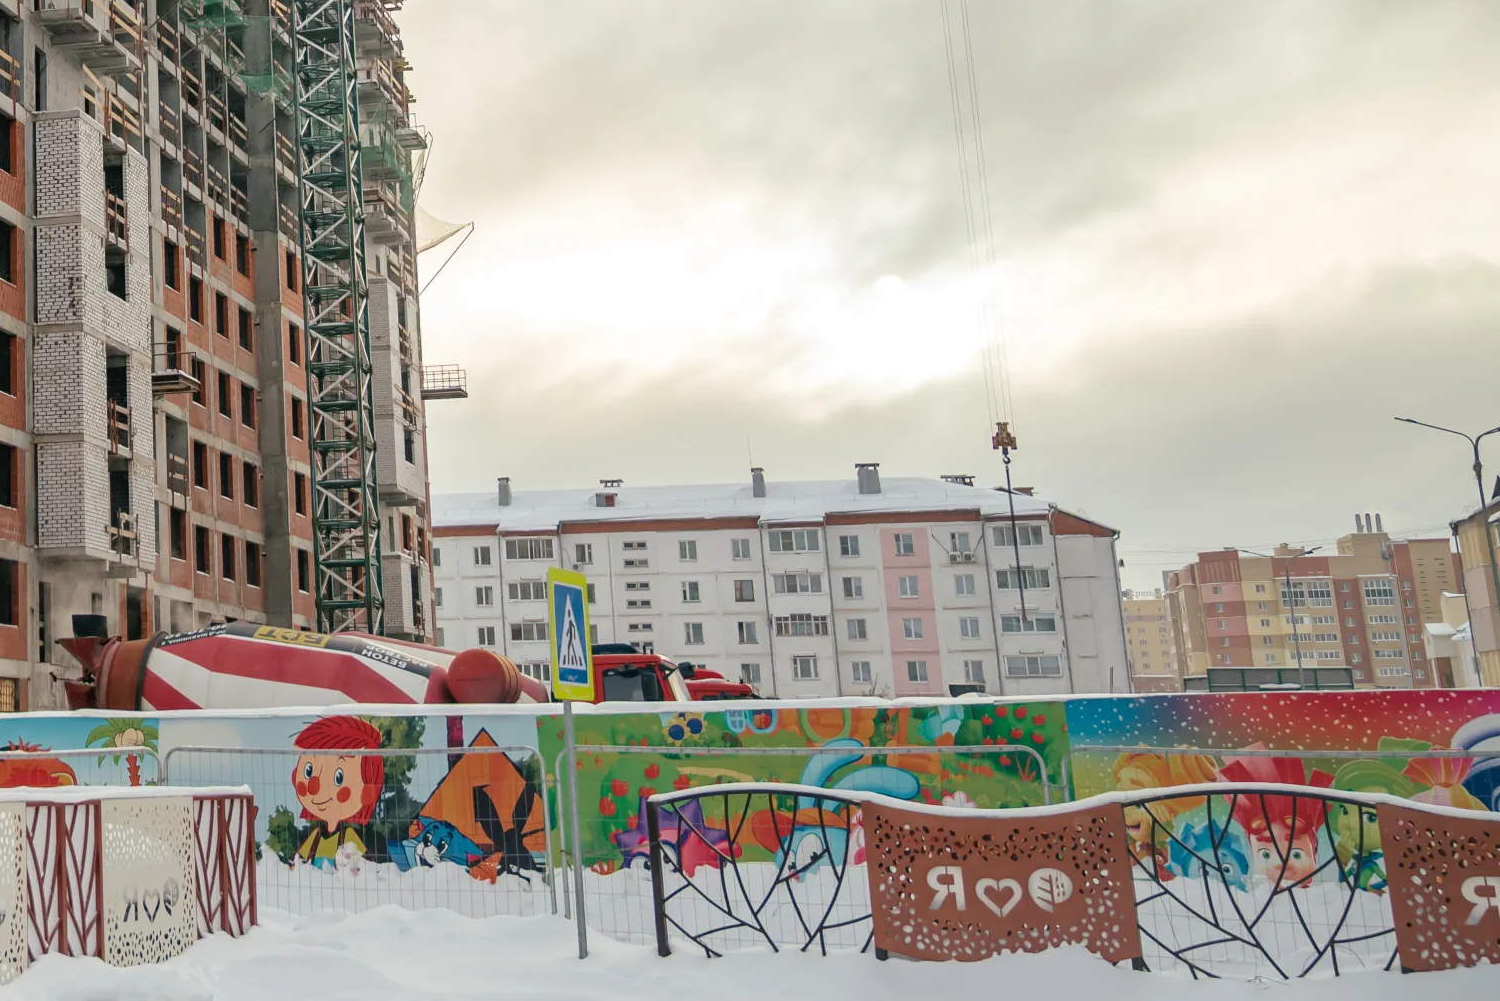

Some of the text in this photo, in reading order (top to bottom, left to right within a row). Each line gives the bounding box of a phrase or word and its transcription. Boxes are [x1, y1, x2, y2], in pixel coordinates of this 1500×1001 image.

[361, 648, 408, 669] БЕТОН
[365, 645, 429, 668] РАСТВОР
[926, 865, 967, 911] Я
[1460, 875, 1500, 927] Я
